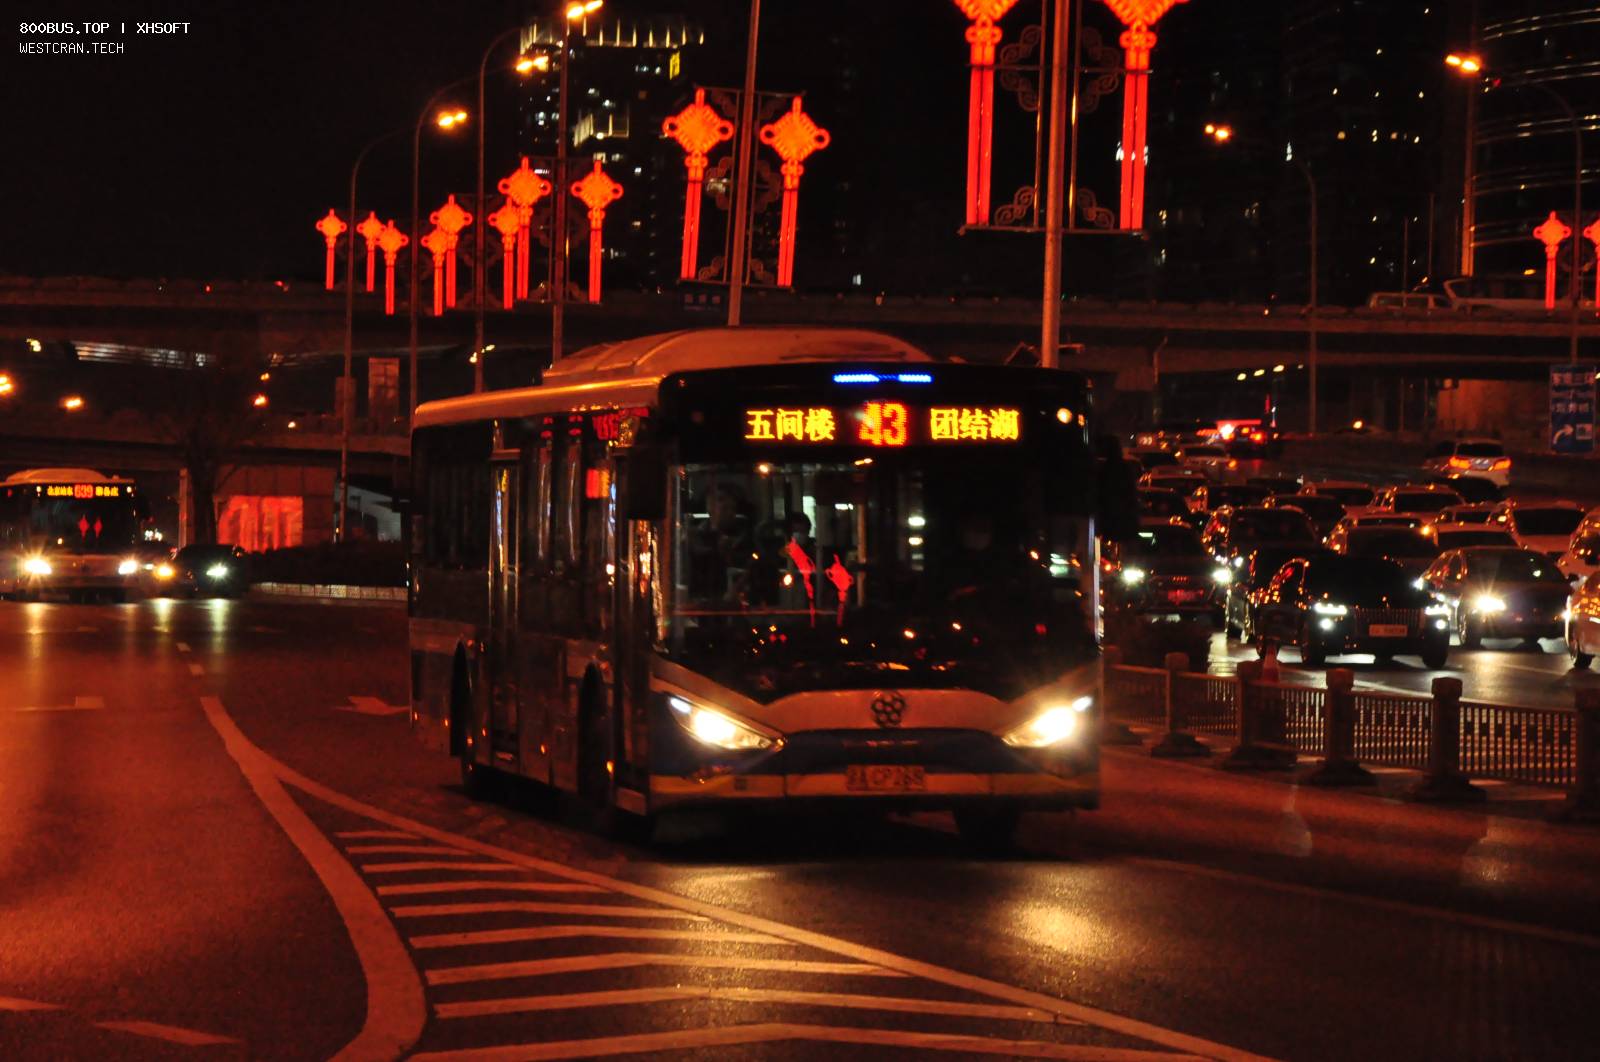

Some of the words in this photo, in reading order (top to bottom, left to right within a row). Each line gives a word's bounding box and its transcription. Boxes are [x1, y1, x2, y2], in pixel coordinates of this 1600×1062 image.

[744, 408, 836, 441] 五间楼
[853, 402, 908, 446] 43
[929, 407, 1020, 441] 团结湖
